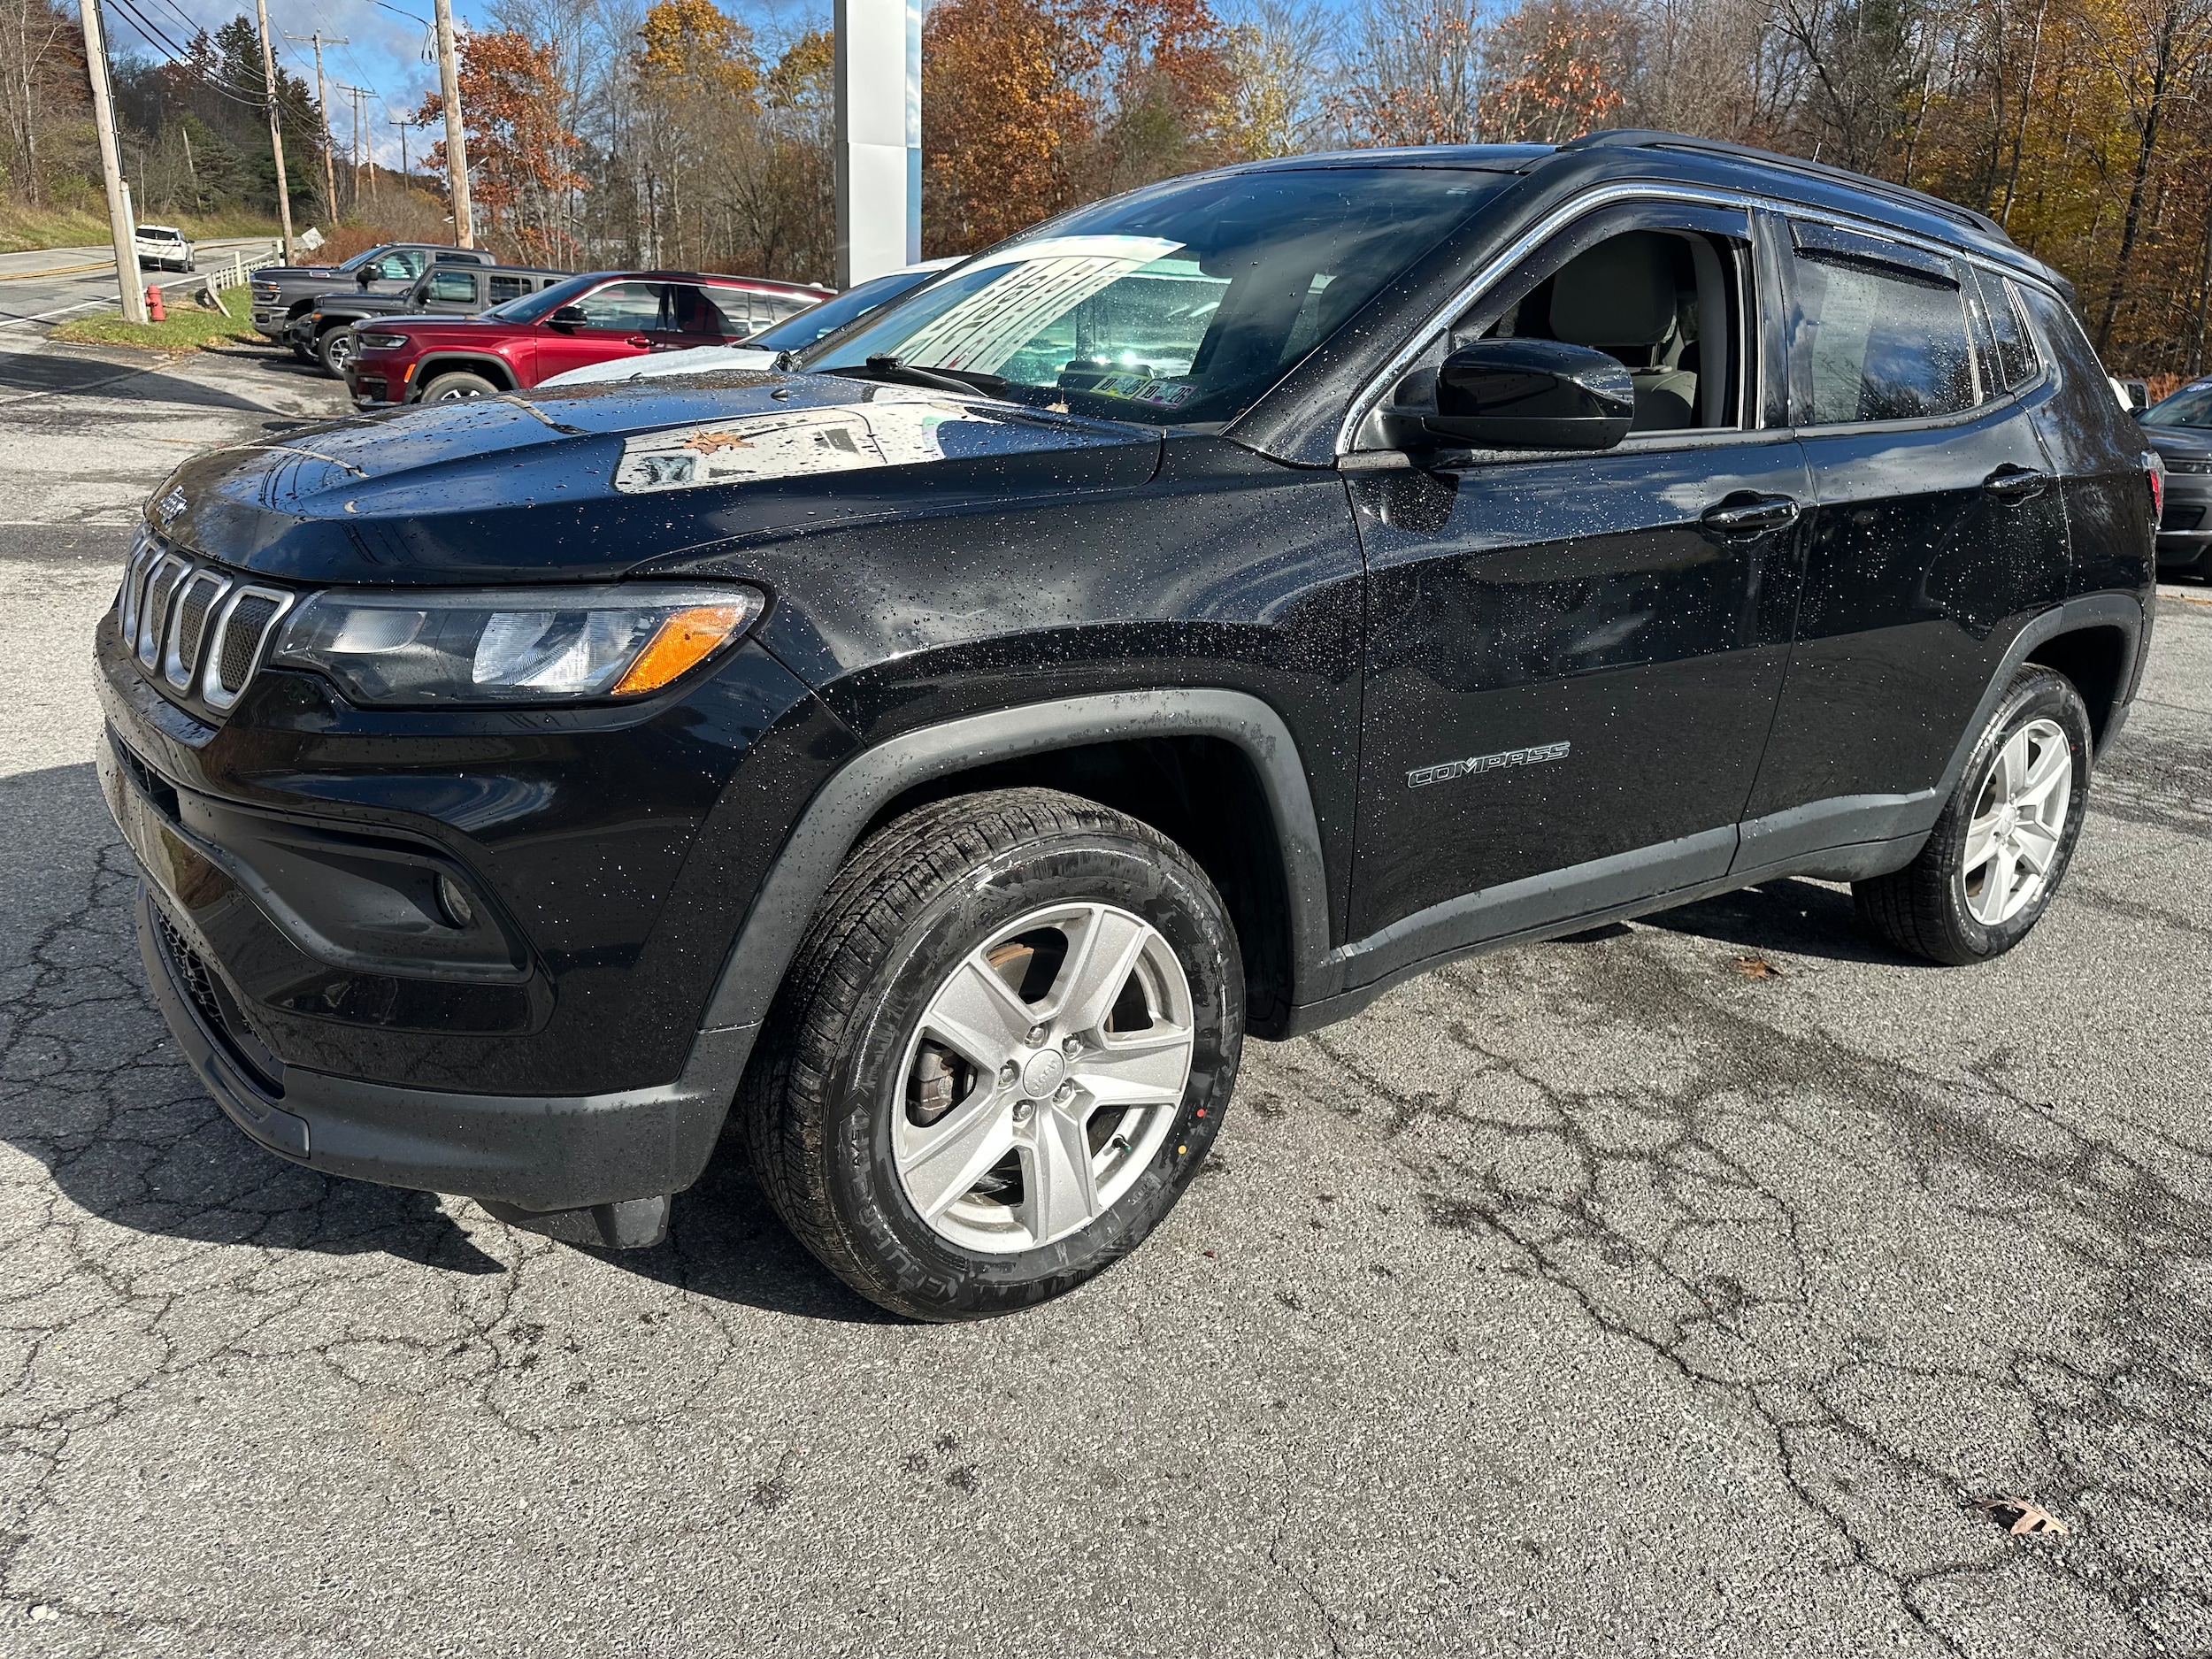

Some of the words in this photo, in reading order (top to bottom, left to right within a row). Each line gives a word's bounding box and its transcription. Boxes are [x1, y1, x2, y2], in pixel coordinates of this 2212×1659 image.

[1098, 377, 1118, 391] 10
[1141, 385, 1161, 399] 10
[1168, 387, 1192, 403] 26
[1407, 741, 1571, 789] COMPASS
[1032, 1058, 1058, 1092] Jeep
